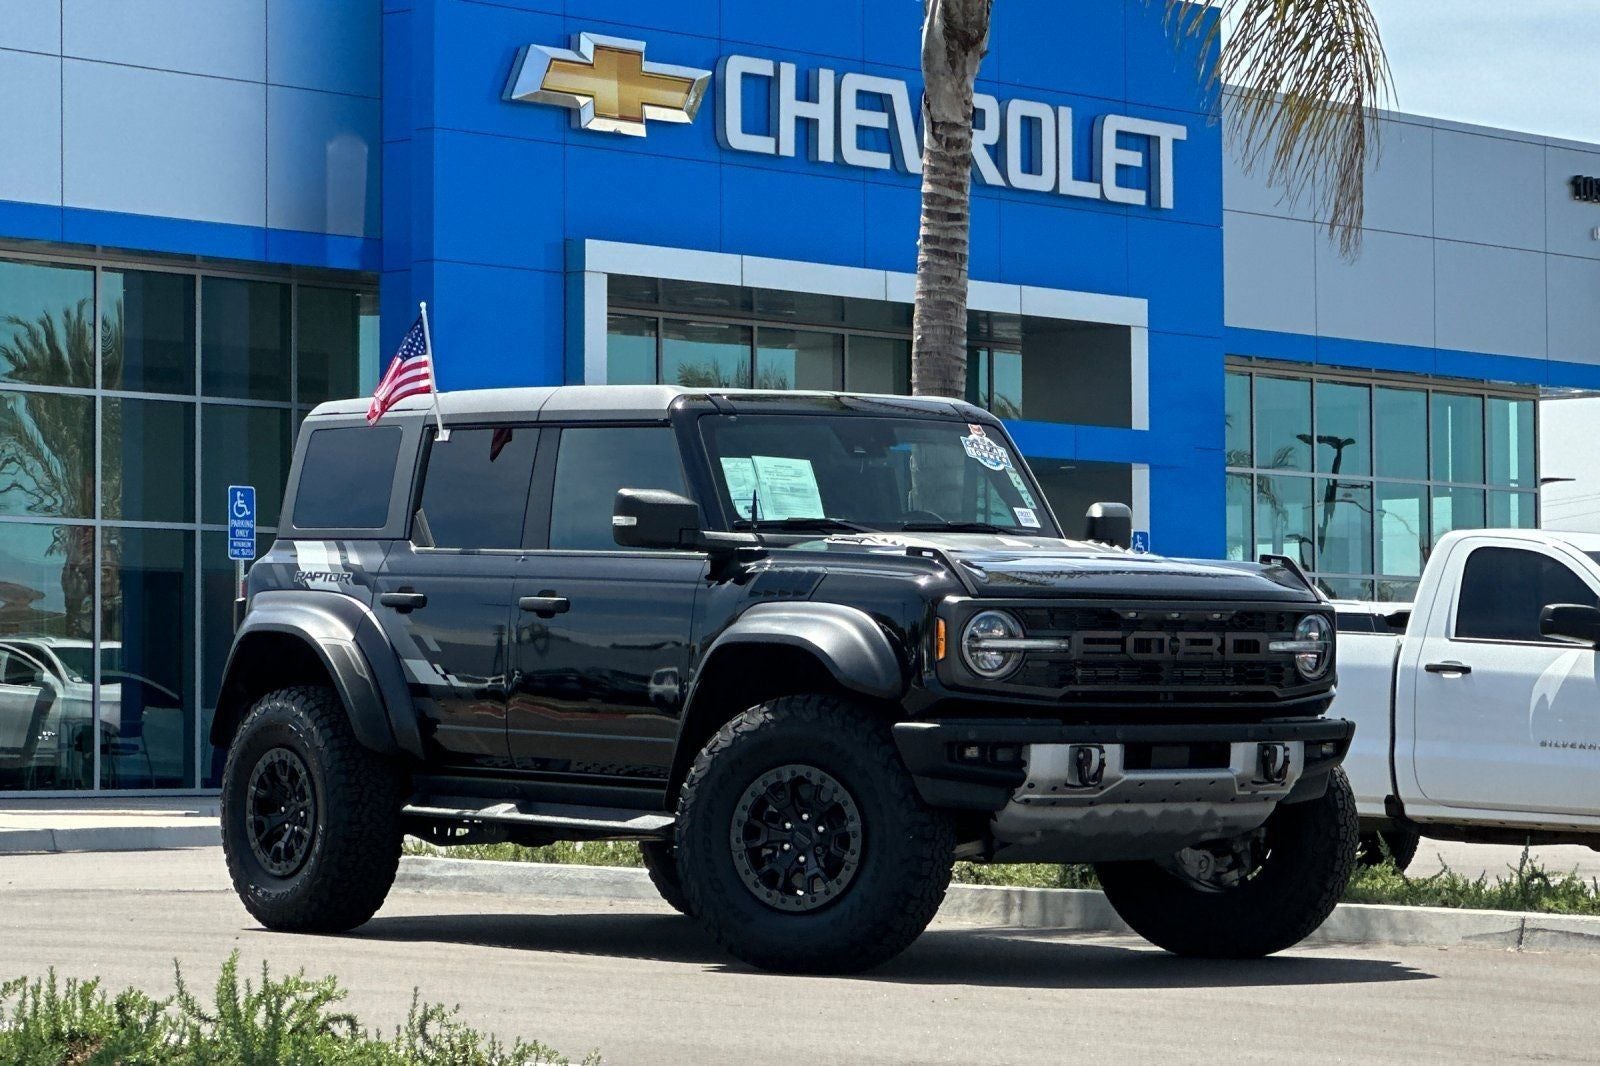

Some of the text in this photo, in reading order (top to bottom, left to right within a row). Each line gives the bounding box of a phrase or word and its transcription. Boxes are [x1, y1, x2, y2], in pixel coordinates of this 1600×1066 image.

[718, 54, 1187, 209] CHEVROLET
[230, 519, 254, 528] PARKING
[235, 529, 249, 538] ONLY
[293, 570, 353, 589] RAPTOR
[1072, 630, 1269, 662] FORD
[1539, 739, 1600, 750] SILVERA
